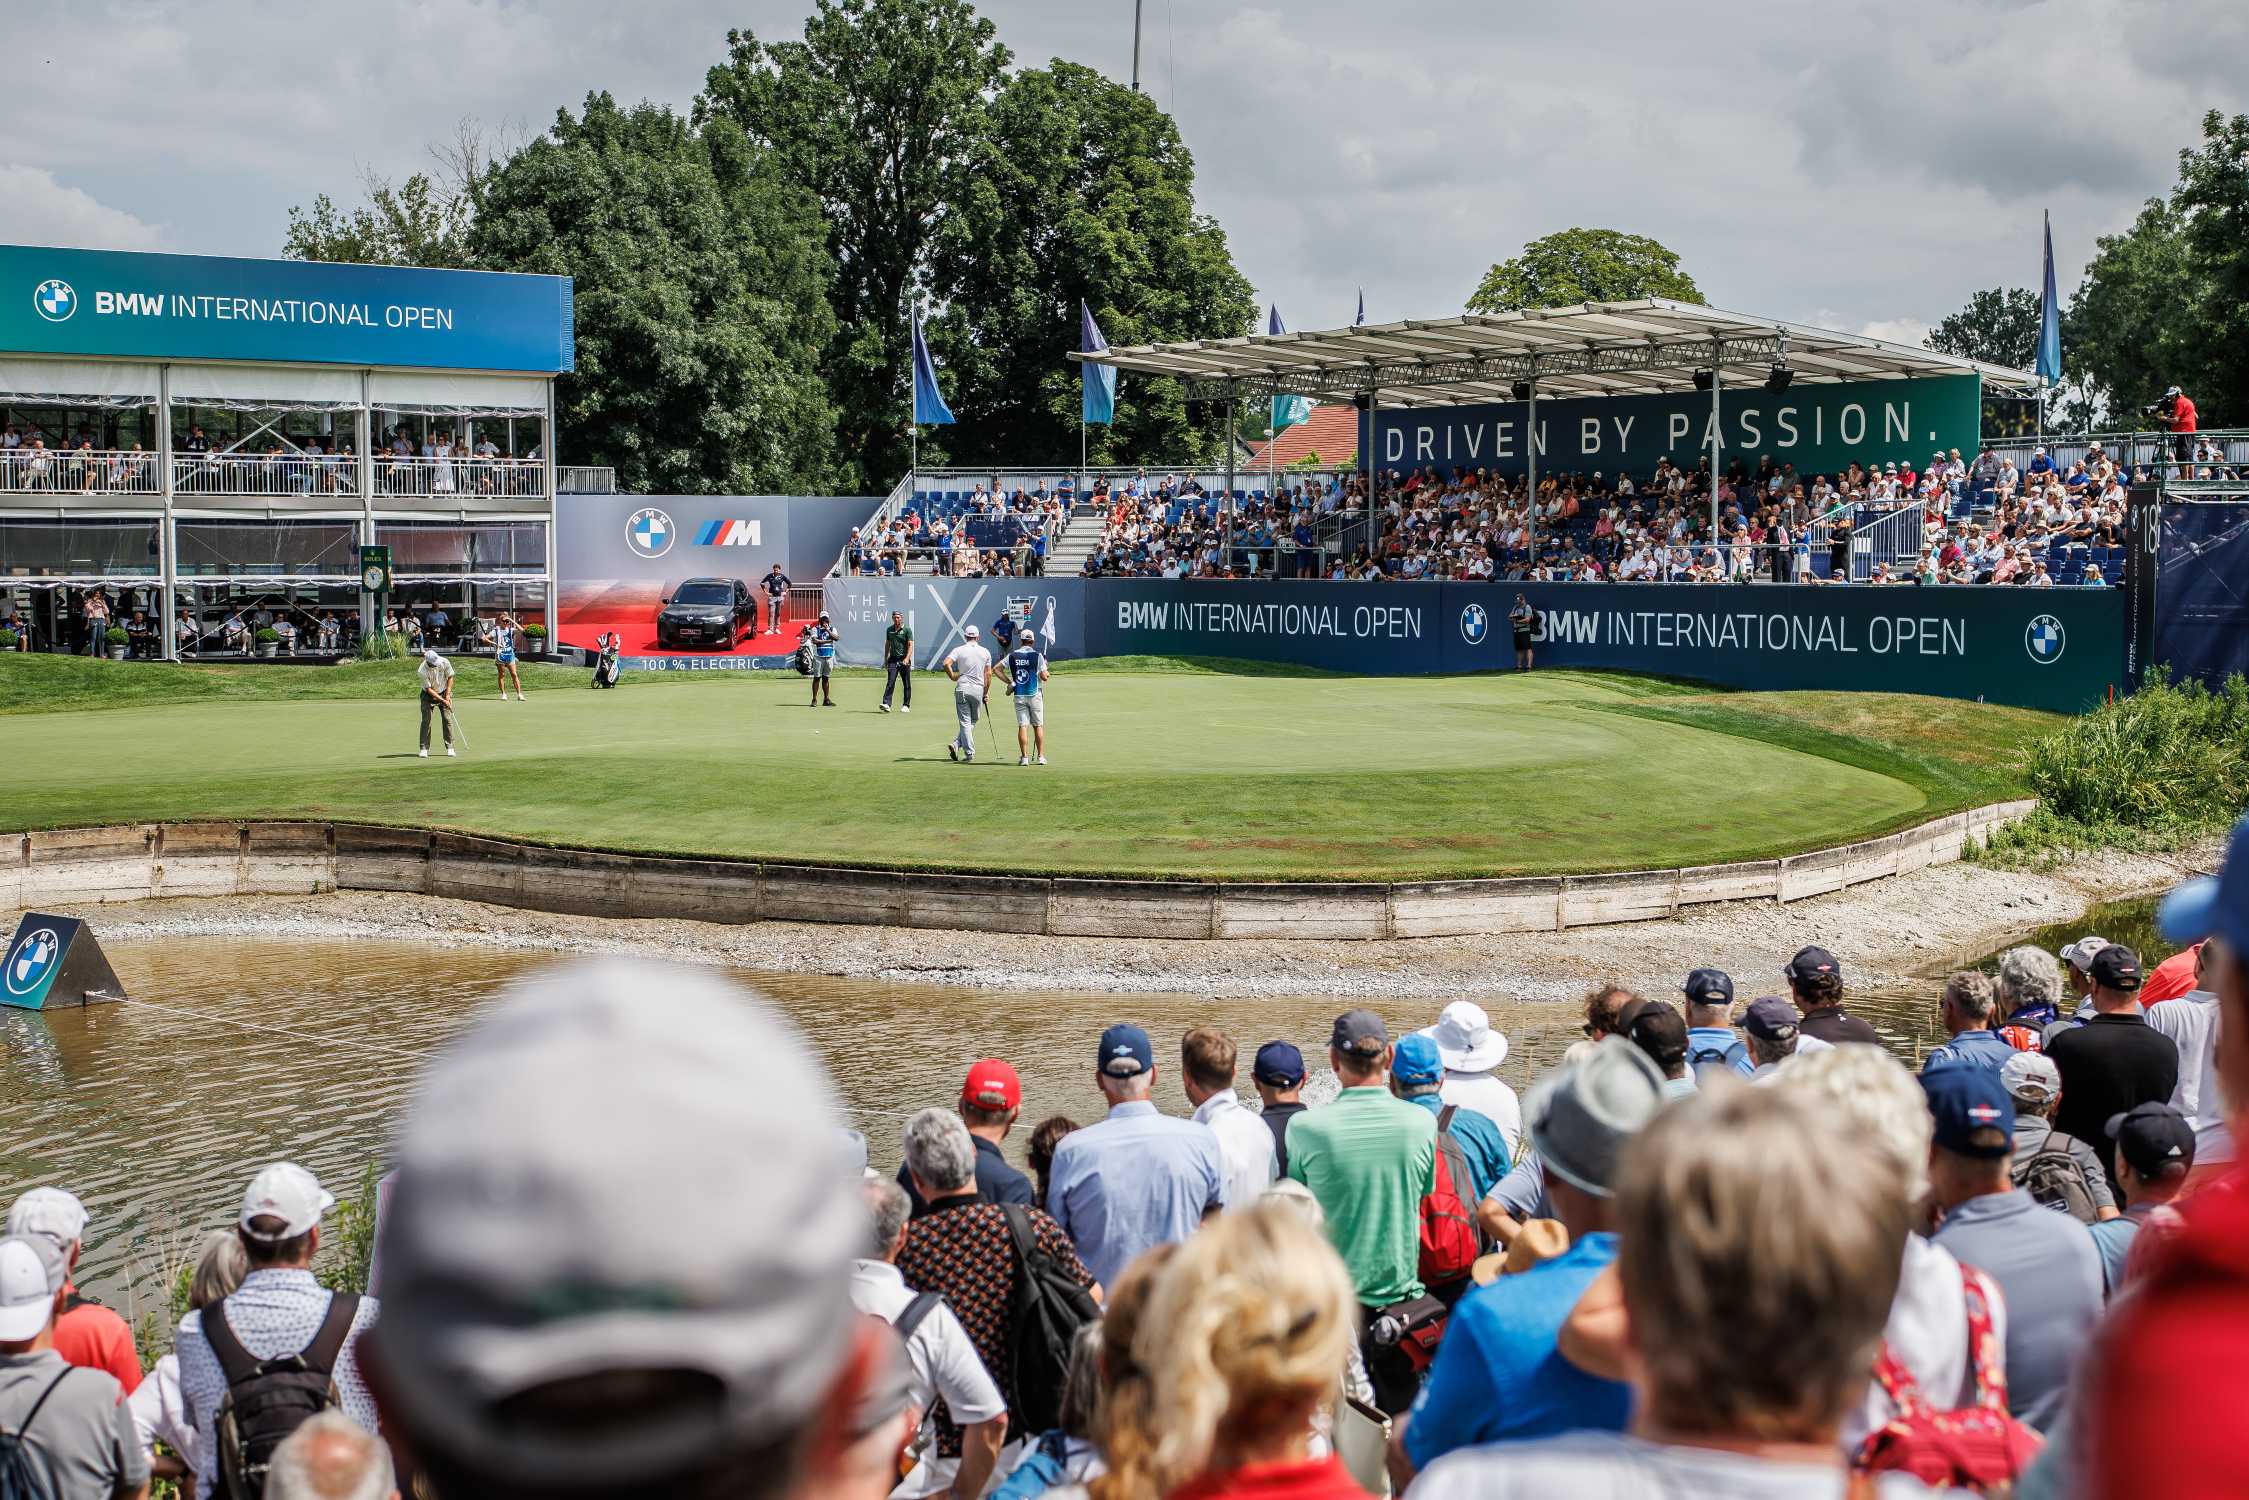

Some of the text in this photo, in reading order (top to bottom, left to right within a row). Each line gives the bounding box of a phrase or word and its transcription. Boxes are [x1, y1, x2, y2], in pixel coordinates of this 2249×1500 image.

[95, 291, 453, 330] BMW INTERNATIONAL OPEN
[1386, 402, 1936, 462] DRIVEN BY PASSION.
[2142, 503, 2158, 555] 18
[848, 595, 888, 607] THE
[848, 610, 888, 622] NEW
[1118, 601, 1421, 638] BMW INTERNATIONAL OPEN
[1608, 611, 1858, 652] INTERNATIONAL
[1869, 616, 1965, 656] OPEN
[642, 658, 760, 670] 100 % ELECTRIC
